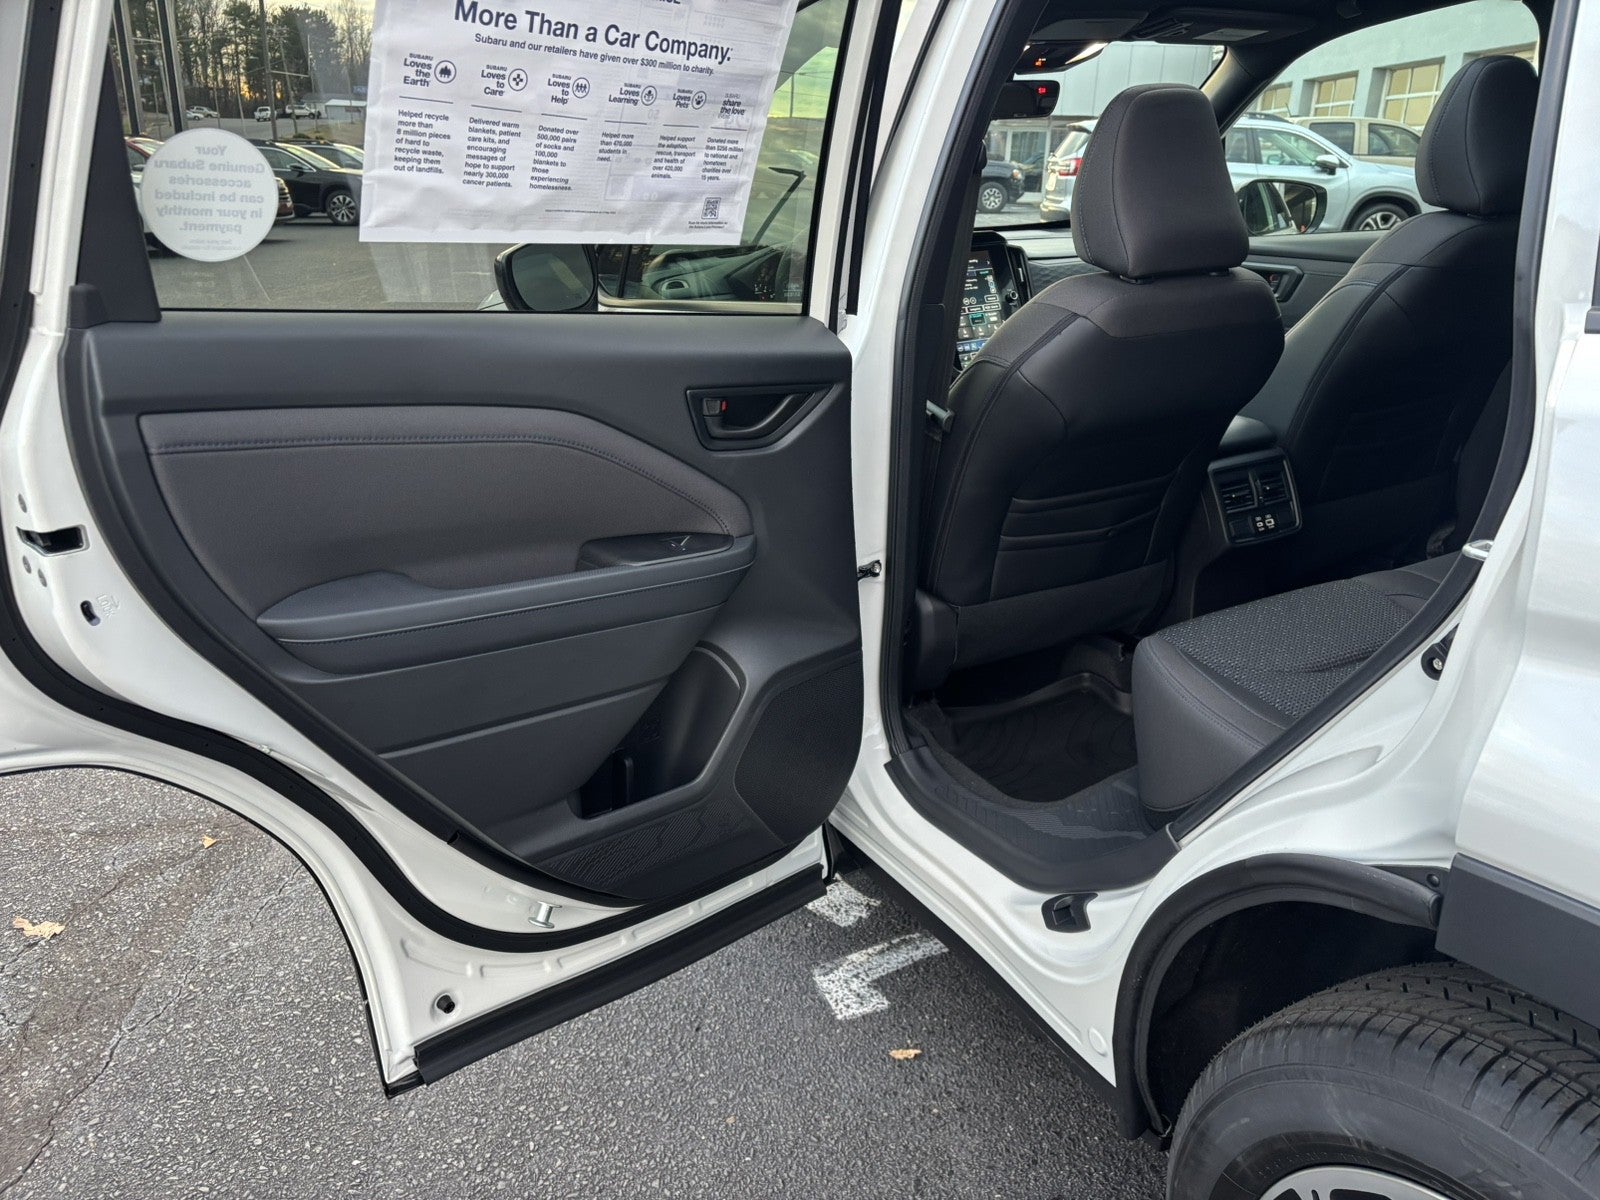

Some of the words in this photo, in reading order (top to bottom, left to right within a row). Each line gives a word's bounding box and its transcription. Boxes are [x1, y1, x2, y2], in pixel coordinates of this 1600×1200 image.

[455, 0, 517, 30] More
[525, 10, 579, 39] Than
[585, 25, 598, 43] a
[604, 24, 640, 48] Car
[409, 53, 434, 61] SUBARU
[475, 32, 507, 47] Subaru
[509, 40, 526, 49] and
[528, 44, 542, 52] our
[544, 45, 577, 57] retailers
[579, 49, 599, 60] have
[600, 52, 621, 63] given
[622, 56, 639, 65] over
[640, 58, 658, 68] $300
[658, 60, 681, 71] million
[682, 63, 690, 72] to
[691, 64, 714, 76] charity.
[404, 58, 432, 70] Loves
[415, 69, 431, 79] the
[481, 70, 506, 81] Loves
[404, 76, 429, 87] Earth
[496, 80, 505, 89] to
[548, 78, 570, 89] Loves
[484, 86, 504, 96] Care
[620, 88, 640, 97] Loves
[551, 95, 568, 105] Help
[608, 94, 639, 106] Learning
[676, 100, 689, 109] Pets
[722, 99, 742, 107] share
[720, 106, 731, 114] the
[731, 107, 745, 115] love
[398, 110, 422, 120] Helped
[424, 112, 449, 121] recycle
[398, 120, 416, 128] more
[418, 121, 433, 129] than
[469, 117, 500, 127] Delivered
[468, 126, 498, 135] blankets,
[498, 129, 521, 138] patient
[538, 125, 564, 134] Donated
[403, 129, 427, 138] million
[428, 132, 451, 140] pieces
[405, 138, 420, 146] hard
[483, 136, 496, 144] kits,
[395, 146, 420, 155] recycle
[422, 150, 444, 158] waste,
[467, 145, 506, 154] encouraging
[394, 156, 422, 165] keeping
[423, 157, 441, 165] them
[466, 154, 498, 162] messages
[533, 158, 559, 167] blankets
[416, 166, 444, 174] landfills.
[465, 162, 481, 171] hope
[491, 164, 515, 172] support
[486, 180, 512, 188] patients.
[530, 175, 569, 184] experiencing
[529, 183, 572, 191] homelessness.
